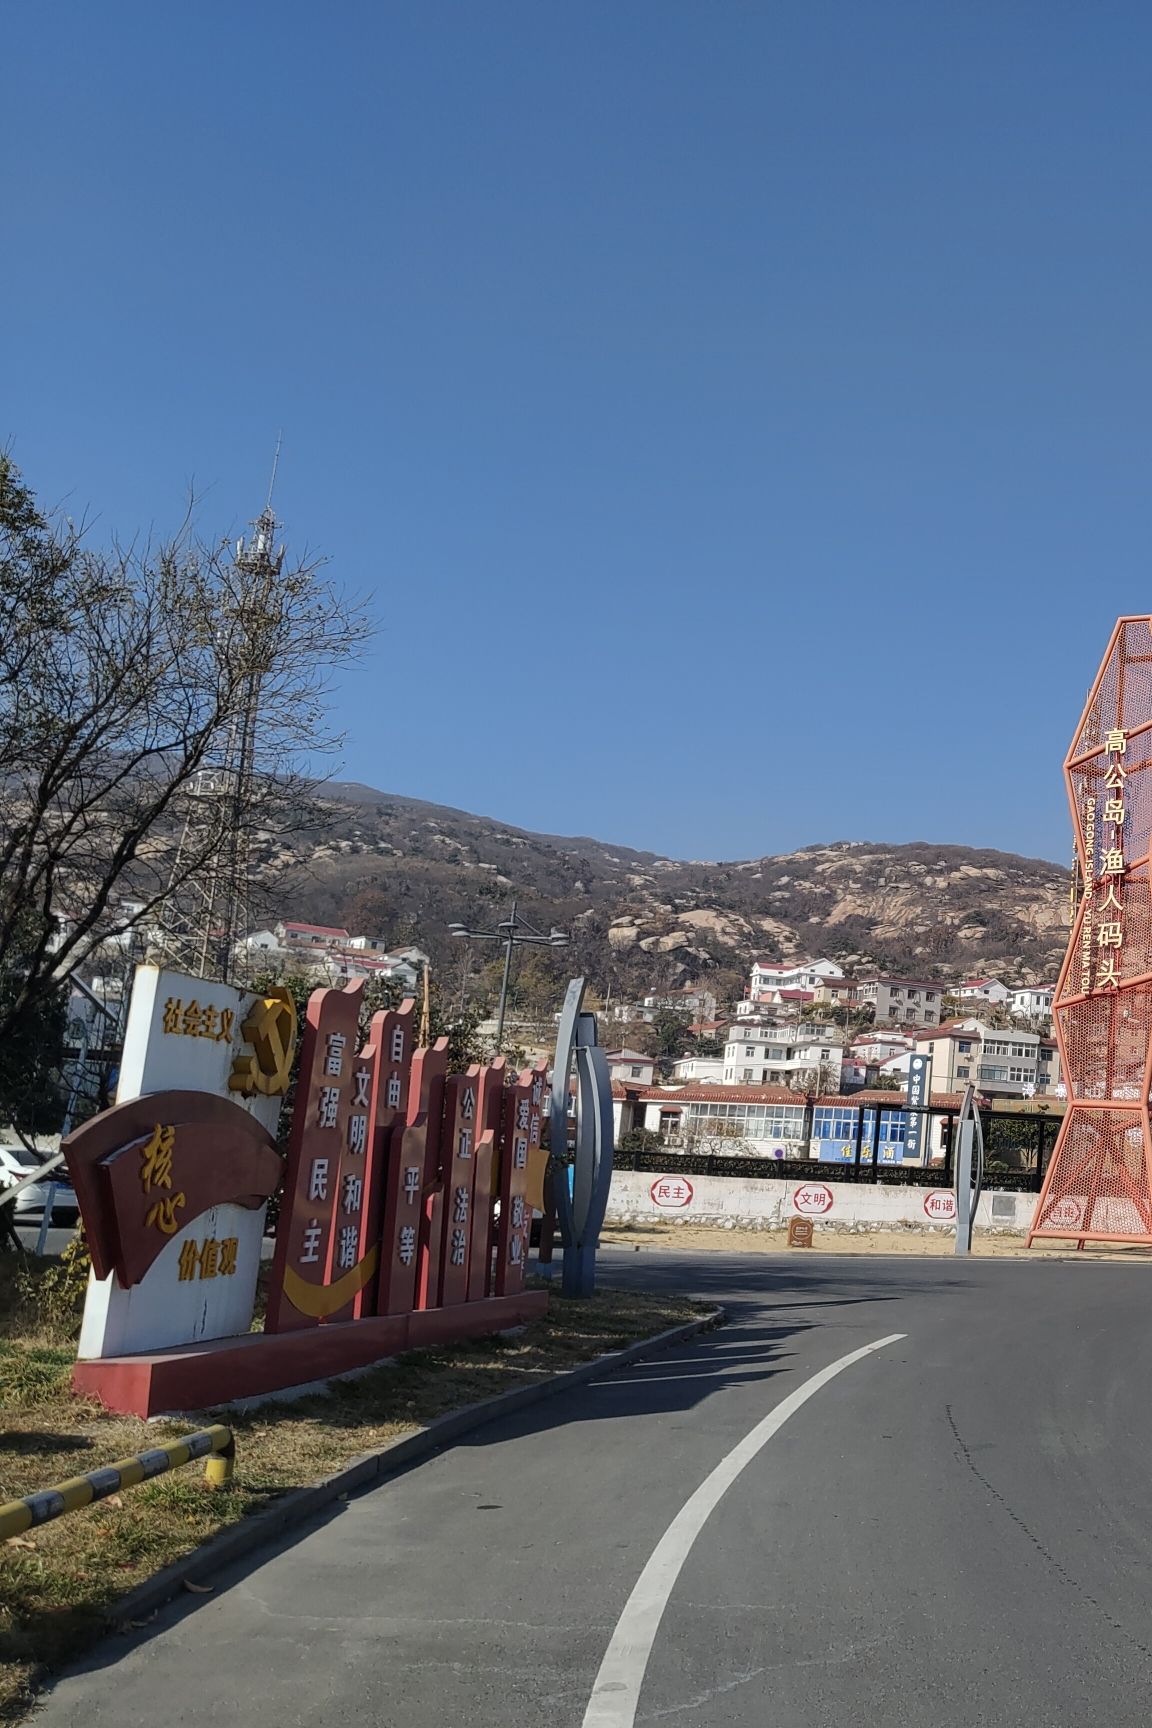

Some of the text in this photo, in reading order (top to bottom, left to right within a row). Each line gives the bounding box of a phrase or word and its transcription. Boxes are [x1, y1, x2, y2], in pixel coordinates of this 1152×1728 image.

[1086, 798, 1096, 821] GAO
[1085, 824, 1095, 855] GONG
[1084, 860, 1094, 899] ISLAND
[1083, 909, 1092, 925] YU
[1082, 928, 1092, 949] REN
[1081, 970, 1090, 994] TOU
[162, 996, 235, 1044] 社会主义
[386, 1024, 405, 1110] 自由
[299, 1032, 347, 1264] 富强 民主
[340, 1066, 371, 1269] 文明 和谐
[142, 1122, 186, 1234] 核心
[451, 1087, 476, 1266] 公正 法治
[657, 1185, 685, 1199] 民主
[400, 1166, 420, 1267] 平等
[800, 1192, 826, 1206] 文明
[929, 1198, 954, 1212] 和谐
[178, 1237, 240, 1282] 价值观
